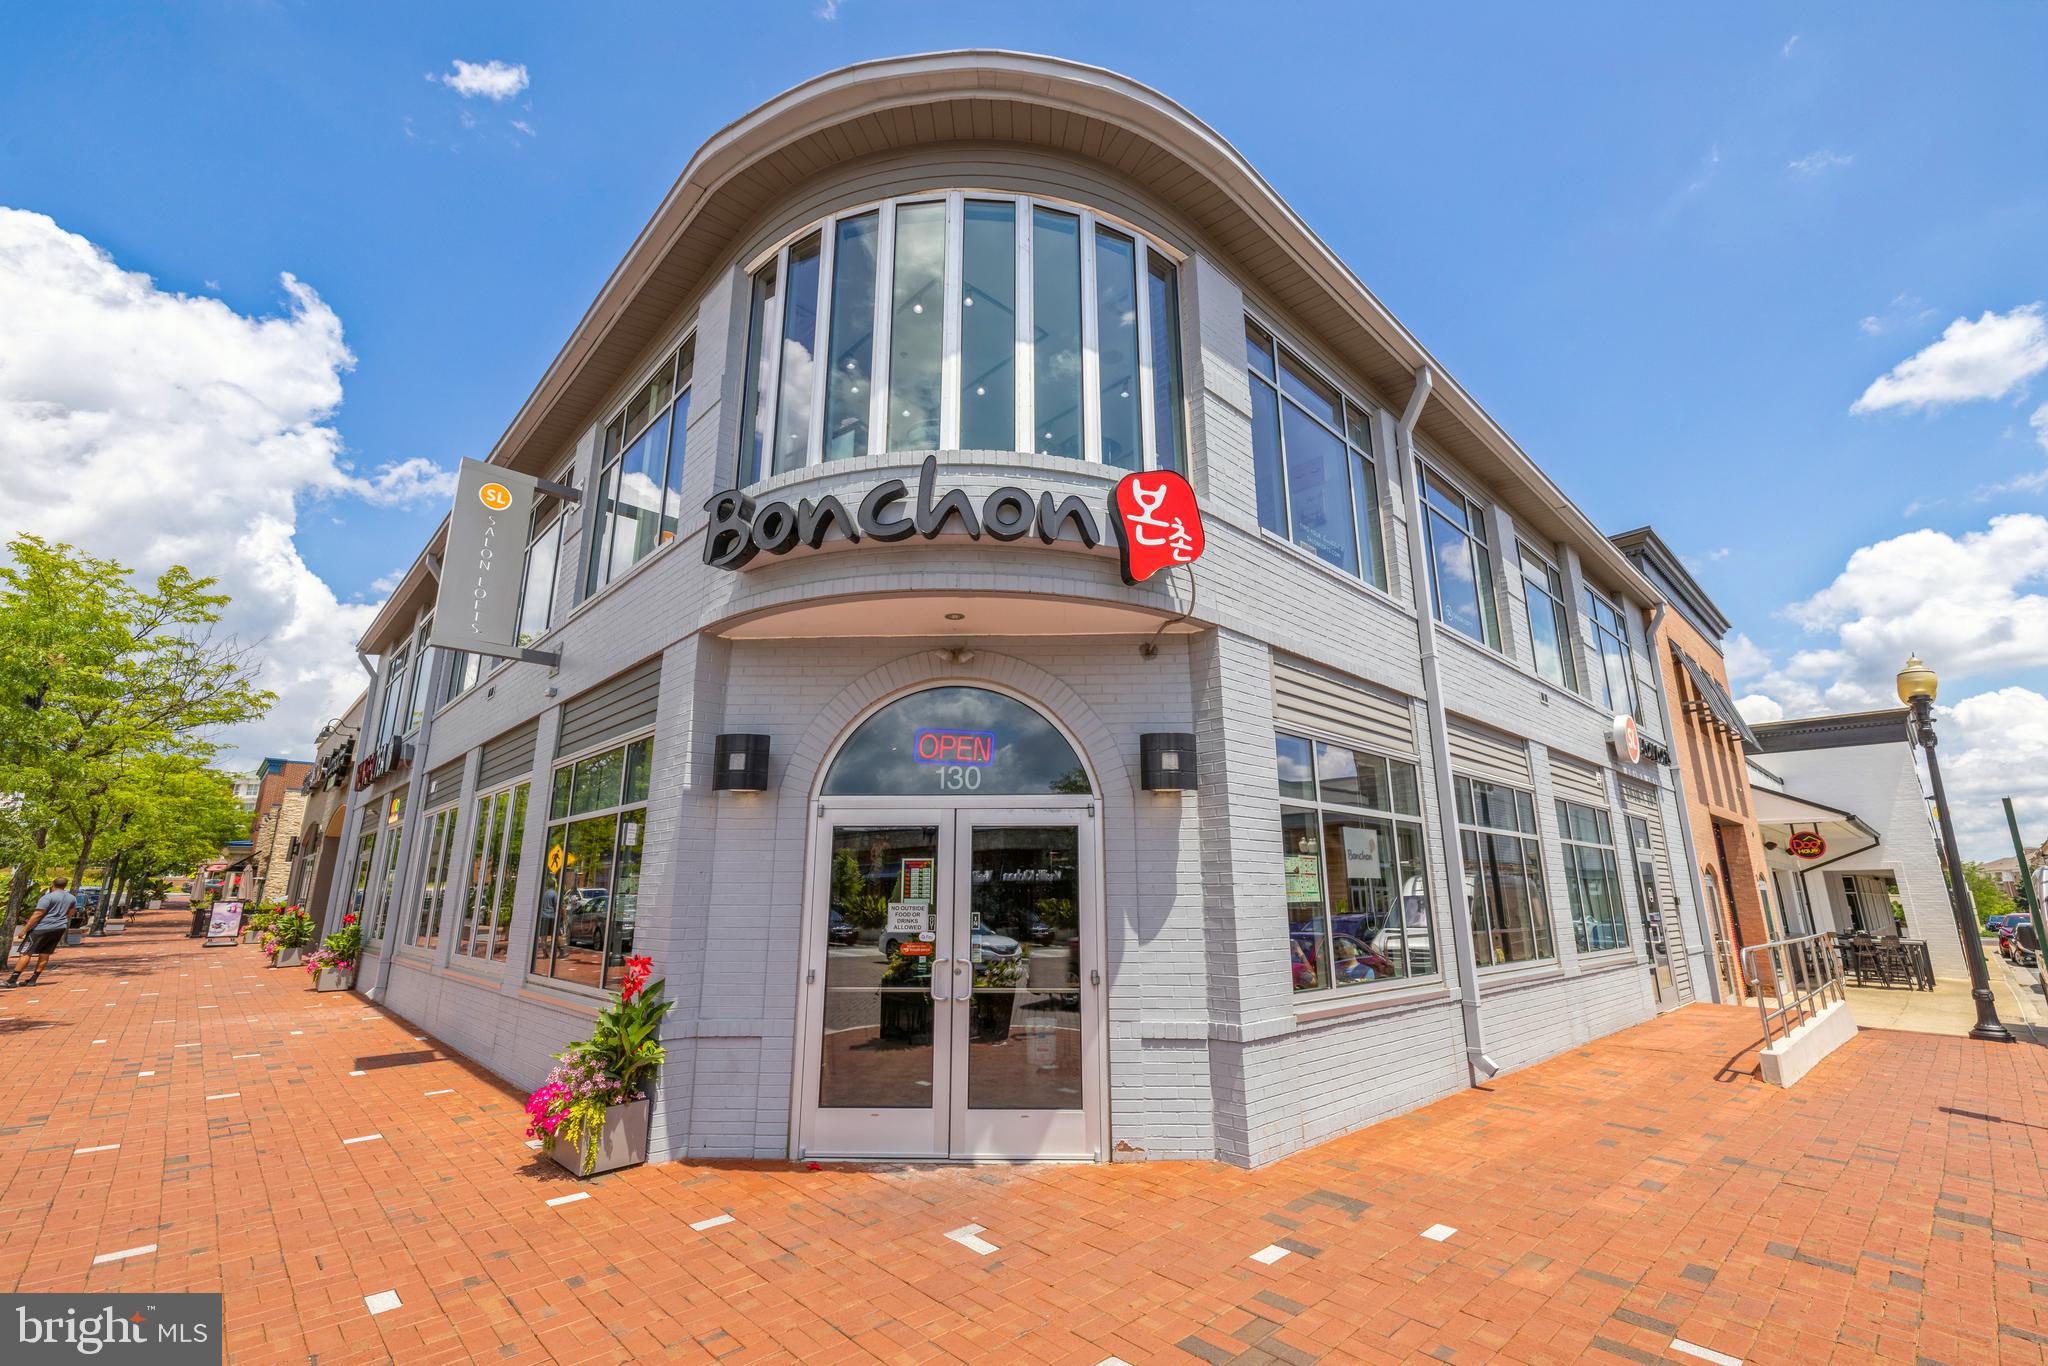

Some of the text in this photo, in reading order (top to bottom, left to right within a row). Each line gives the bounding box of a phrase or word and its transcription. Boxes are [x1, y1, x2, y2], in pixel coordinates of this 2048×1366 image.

[486, 489, 506, 504] SL
[702, 455, 1101, 571] Bonchon
[1127, 478, 1193, 561] 본촌
[919, 733, 992, 762] OPEN
[935, 766, 982, 789] 130
